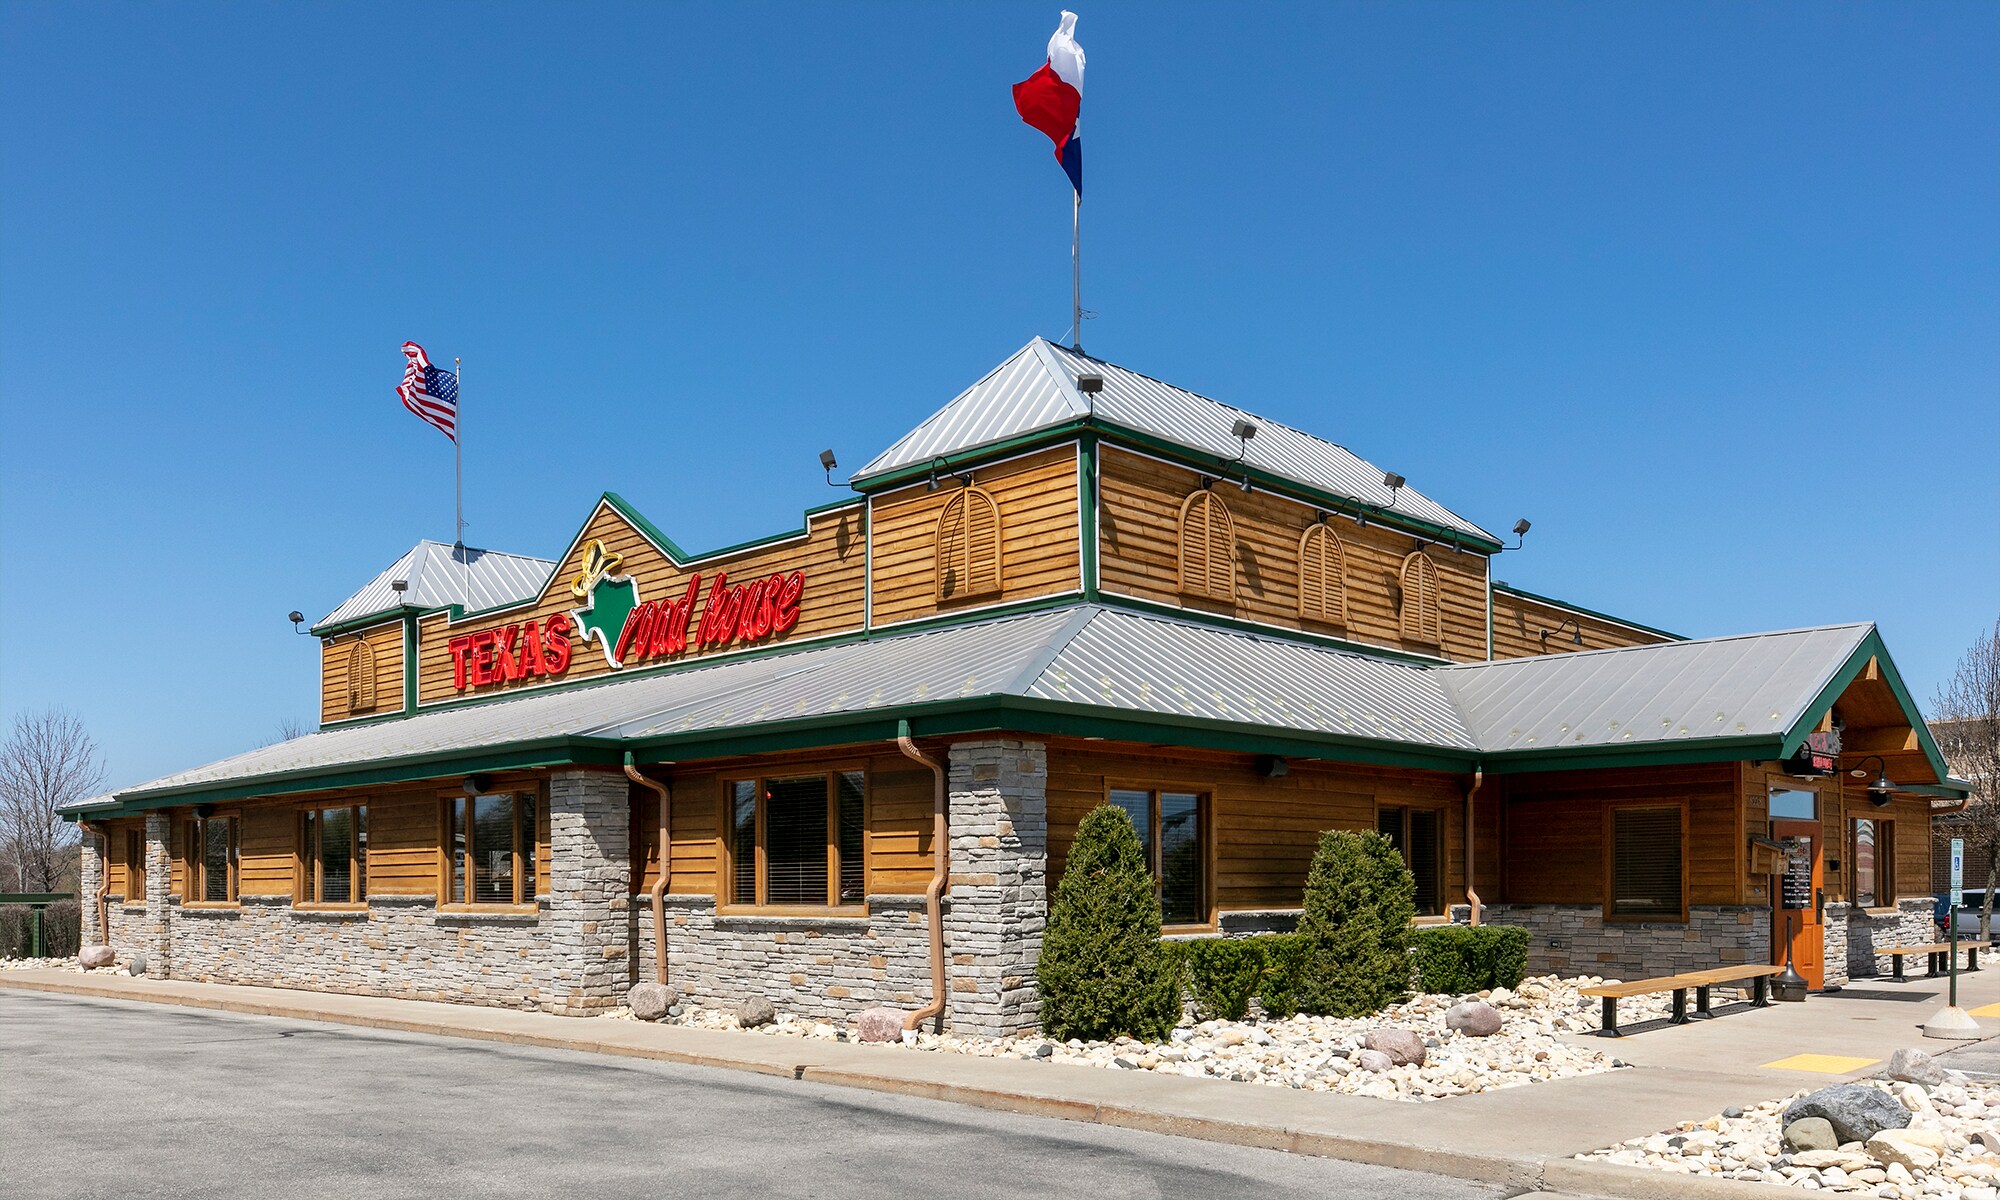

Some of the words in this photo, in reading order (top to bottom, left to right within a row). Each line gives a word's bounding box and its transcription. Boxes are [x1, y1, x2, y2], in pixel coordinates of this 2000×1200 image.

[448, 613, 571, 690] TEXAS
[614, 573, 702, 663] road
[695, 570, 805, 647] house
